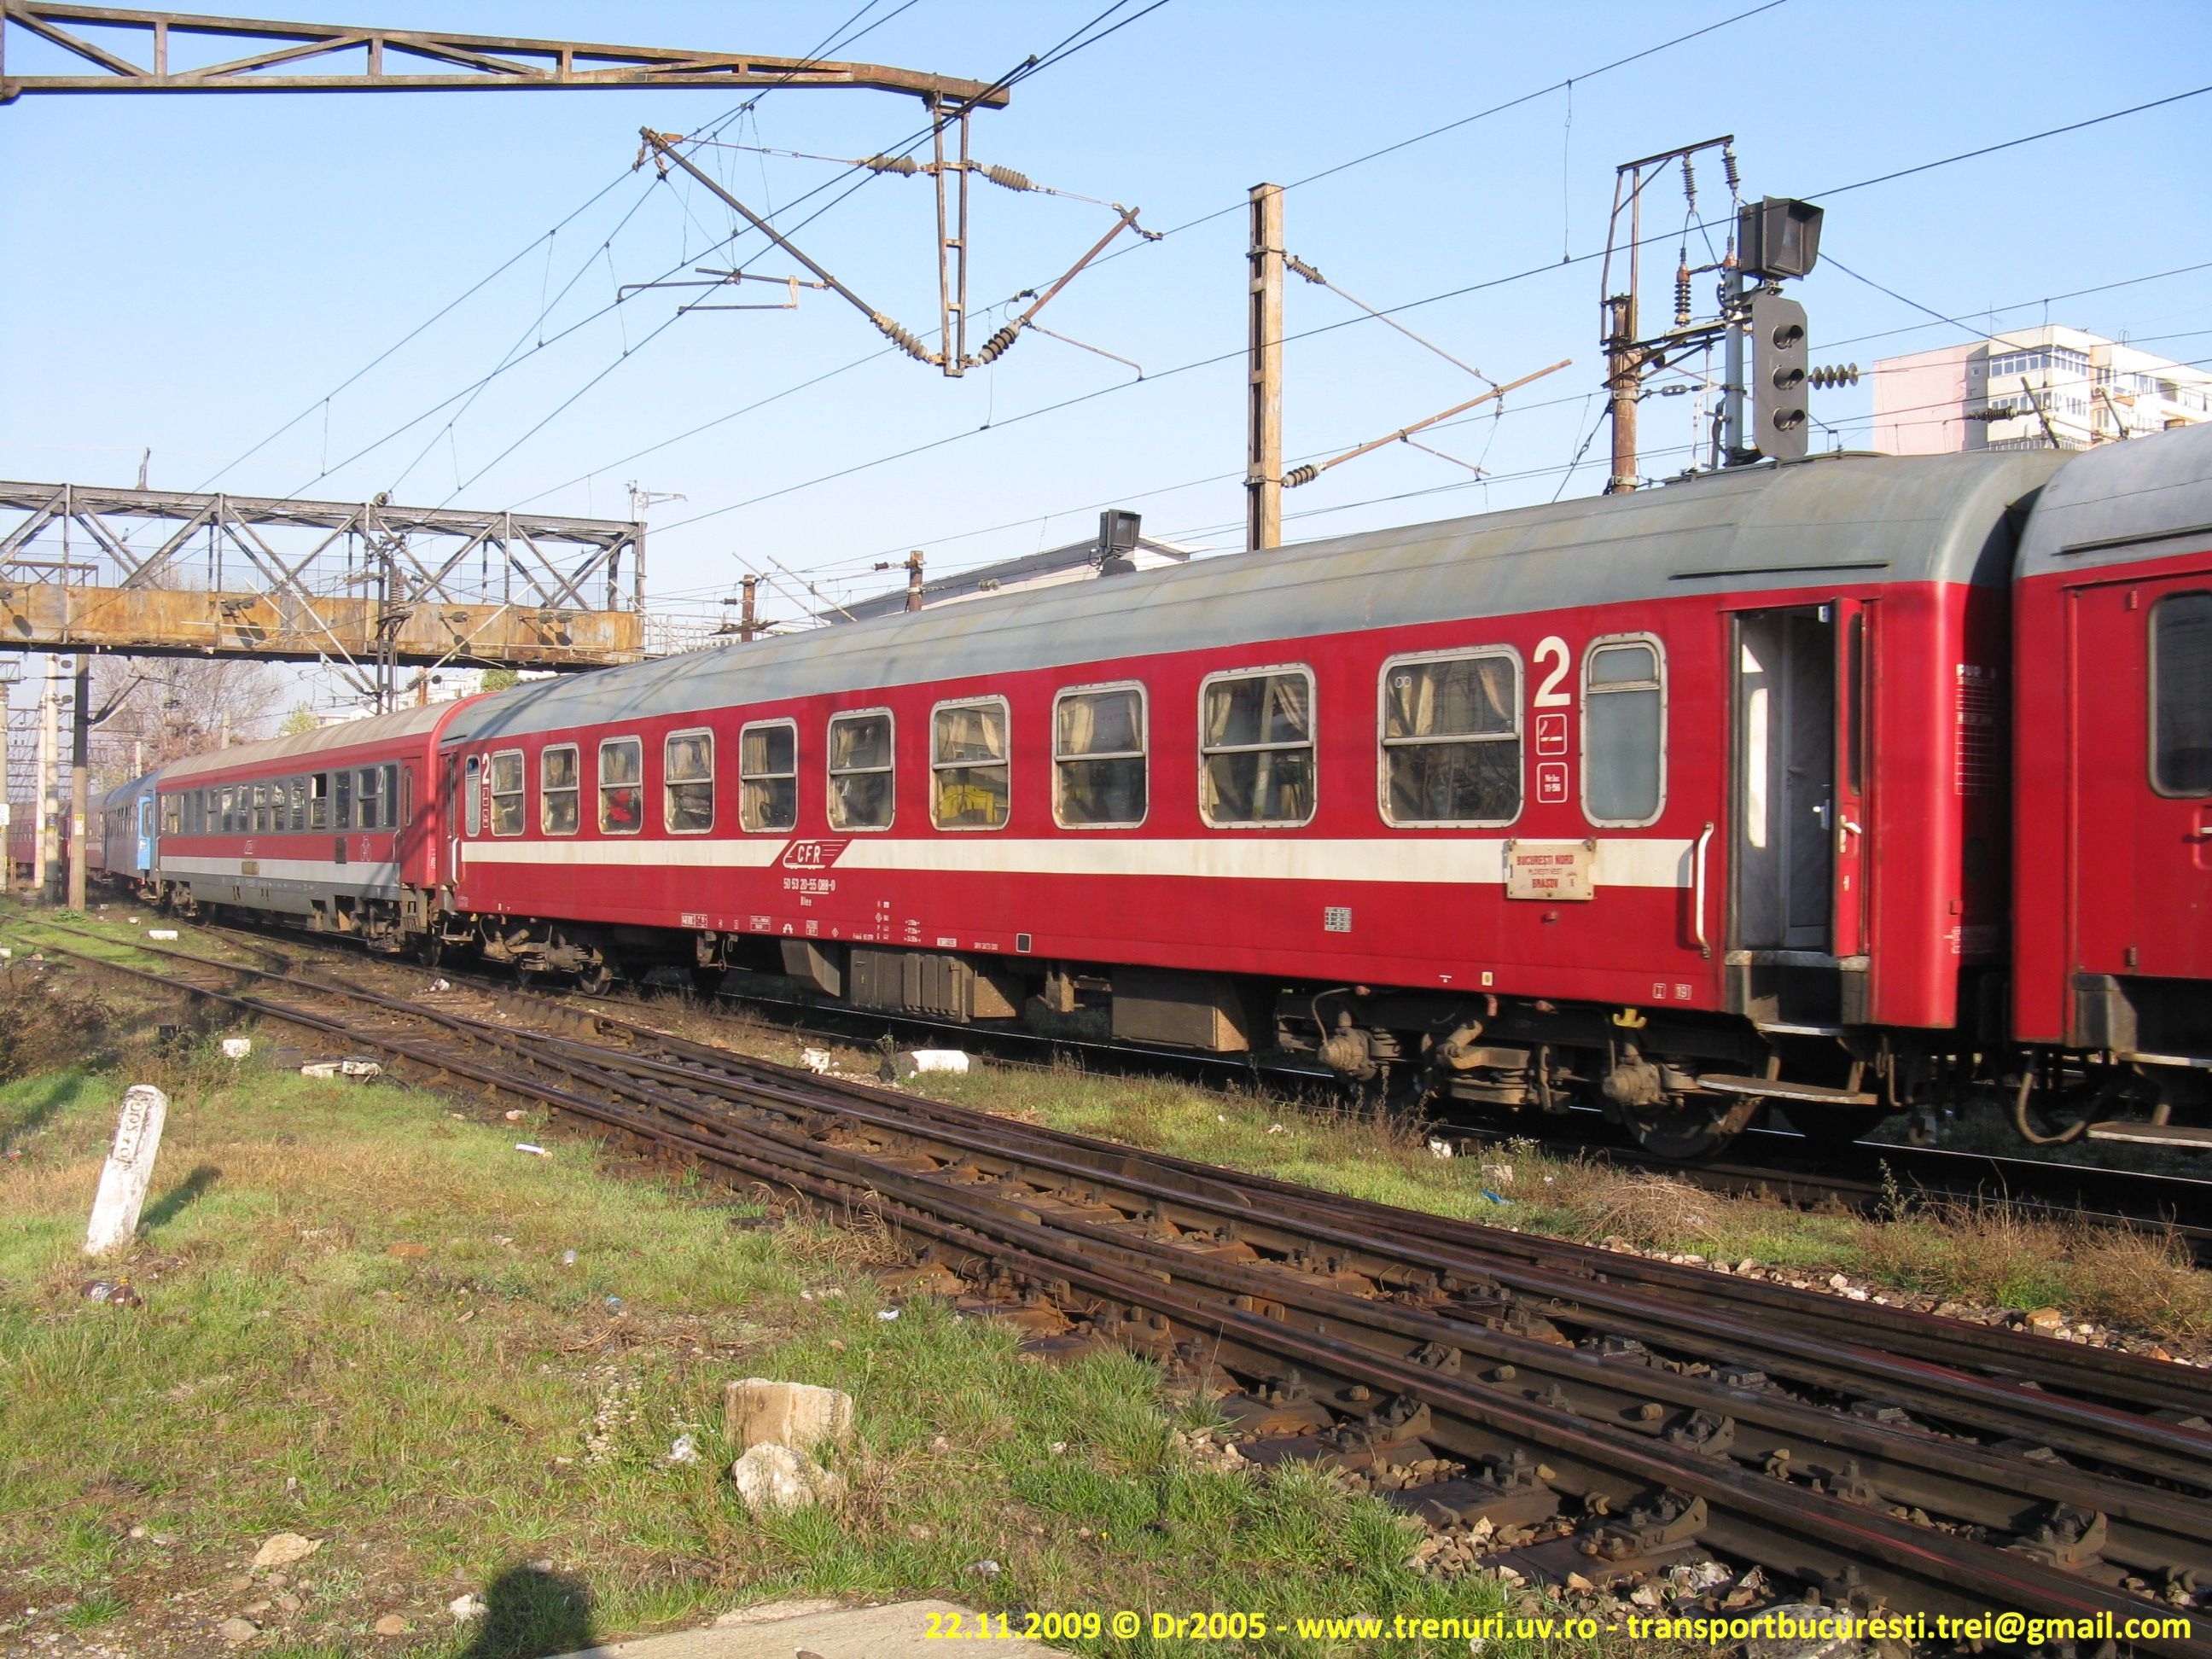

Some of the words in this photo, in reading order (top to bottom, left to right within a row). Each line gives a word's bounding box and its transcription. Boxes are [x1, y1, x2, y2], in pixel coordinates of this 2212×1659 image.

[1533, 636, 1571, 707] 2
[481, 752, 491, 784] 2
[798, 845, 821, 864] CFR
